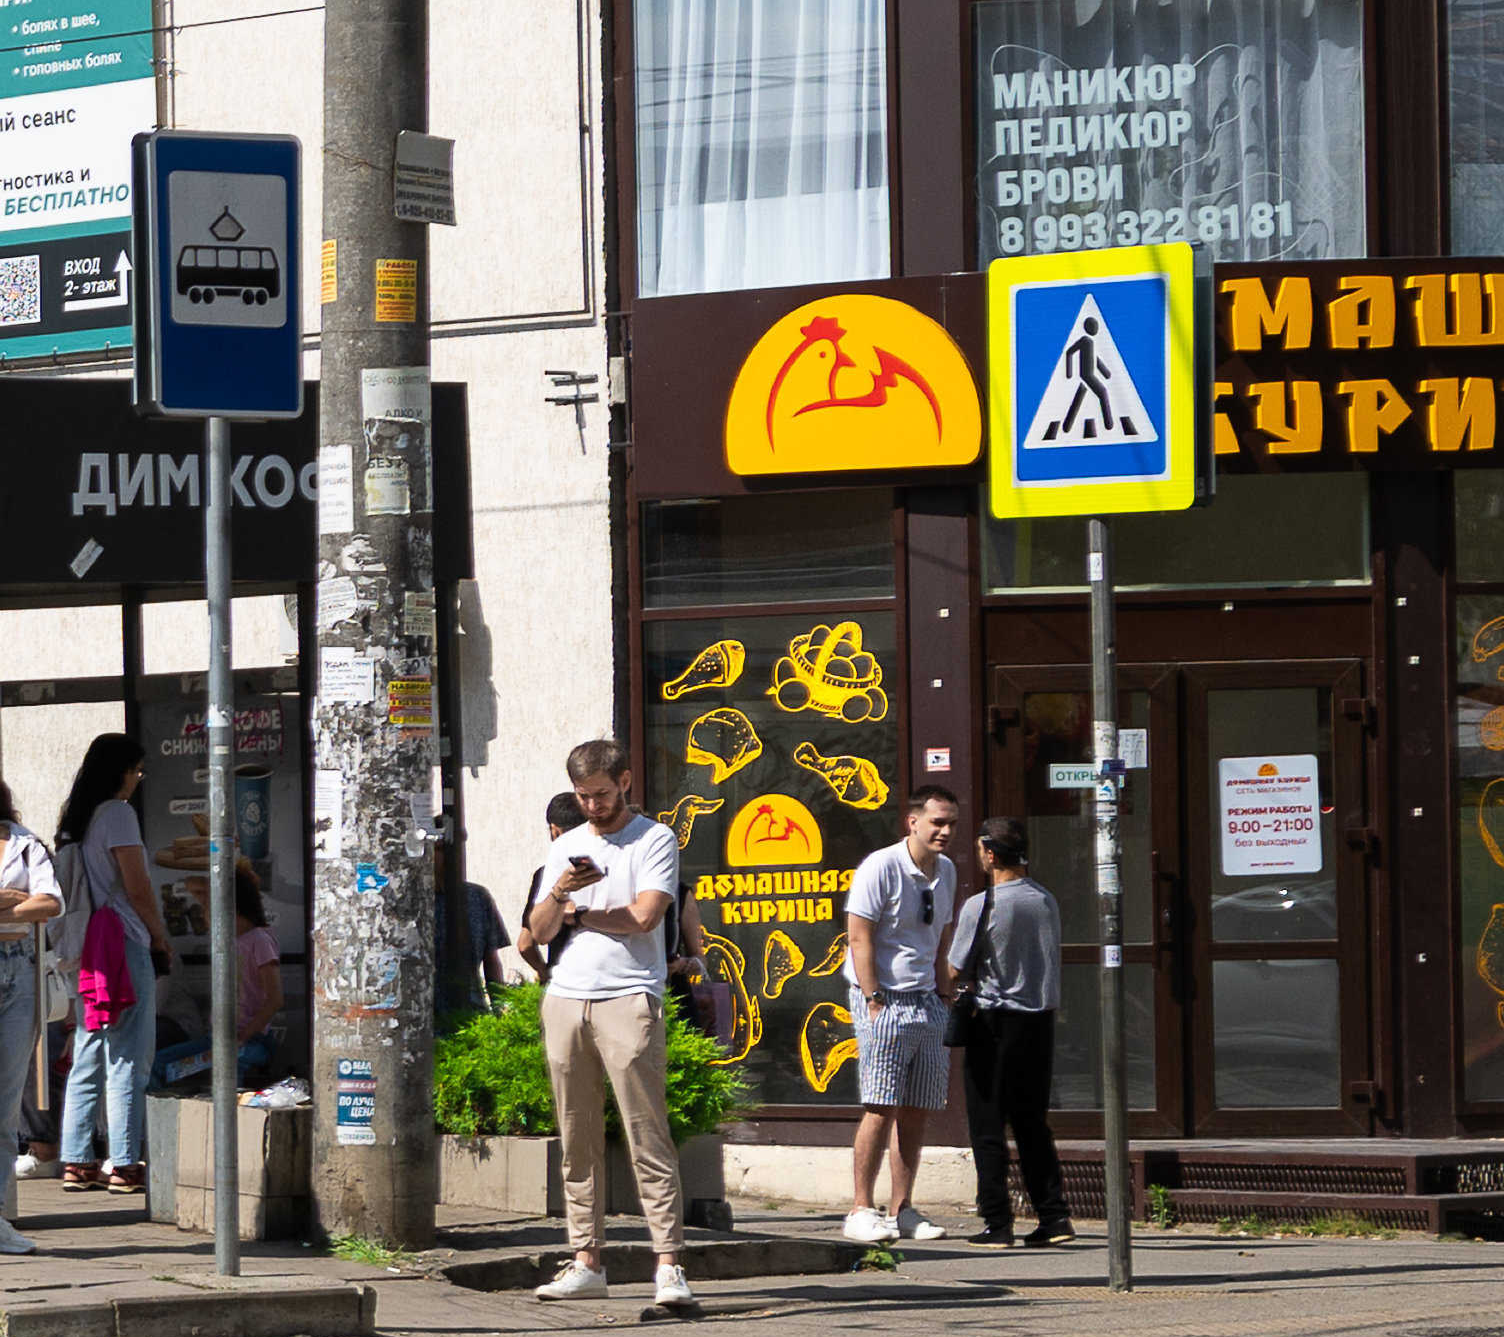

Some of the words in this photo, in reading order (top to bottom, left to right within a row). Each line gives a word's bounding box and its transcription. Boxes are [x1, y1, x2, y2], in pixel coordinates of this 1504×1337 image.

[22, 19, 58, 35] болях
[71, 13, 100, 29] шее,
[23, 59, 82, 77] головных
[86, 52, 122, 69] болях
[994, 63, 1196, 109] МАНИКЮР
[22, 107, 76, 129] сеанс
[996, 111, 1192, 157] ПЕДИКЮР
[82, 168, 90, 181] и
[998, 164, 1124, 207] БРОВИ
[4, 183, 130, 216] БЕСПЛАТНО
[1000, 216, 1024, 253] 8
[1034, 211, 1106, 252] 993
[1116, 207, 1184, 245] 322
[1198, 204, 1238, 241] 81
[1250, 201, 1292, 237] 81
[64, 257, 101, 276] ВХОД
[82, 277, 116, 294] этаж
[72, 453, 200, 515] ДИМ
[1228, 807, 1268, 815] РЕЖИМ
[1269, 805, 1312, 813] РАБОТЫ
[1256, 839, 1307, 847] выходных
[696, 869, 856, 900] ДОМАШНЯЯ
[721, 898, 832, 924] КУРИЦА
